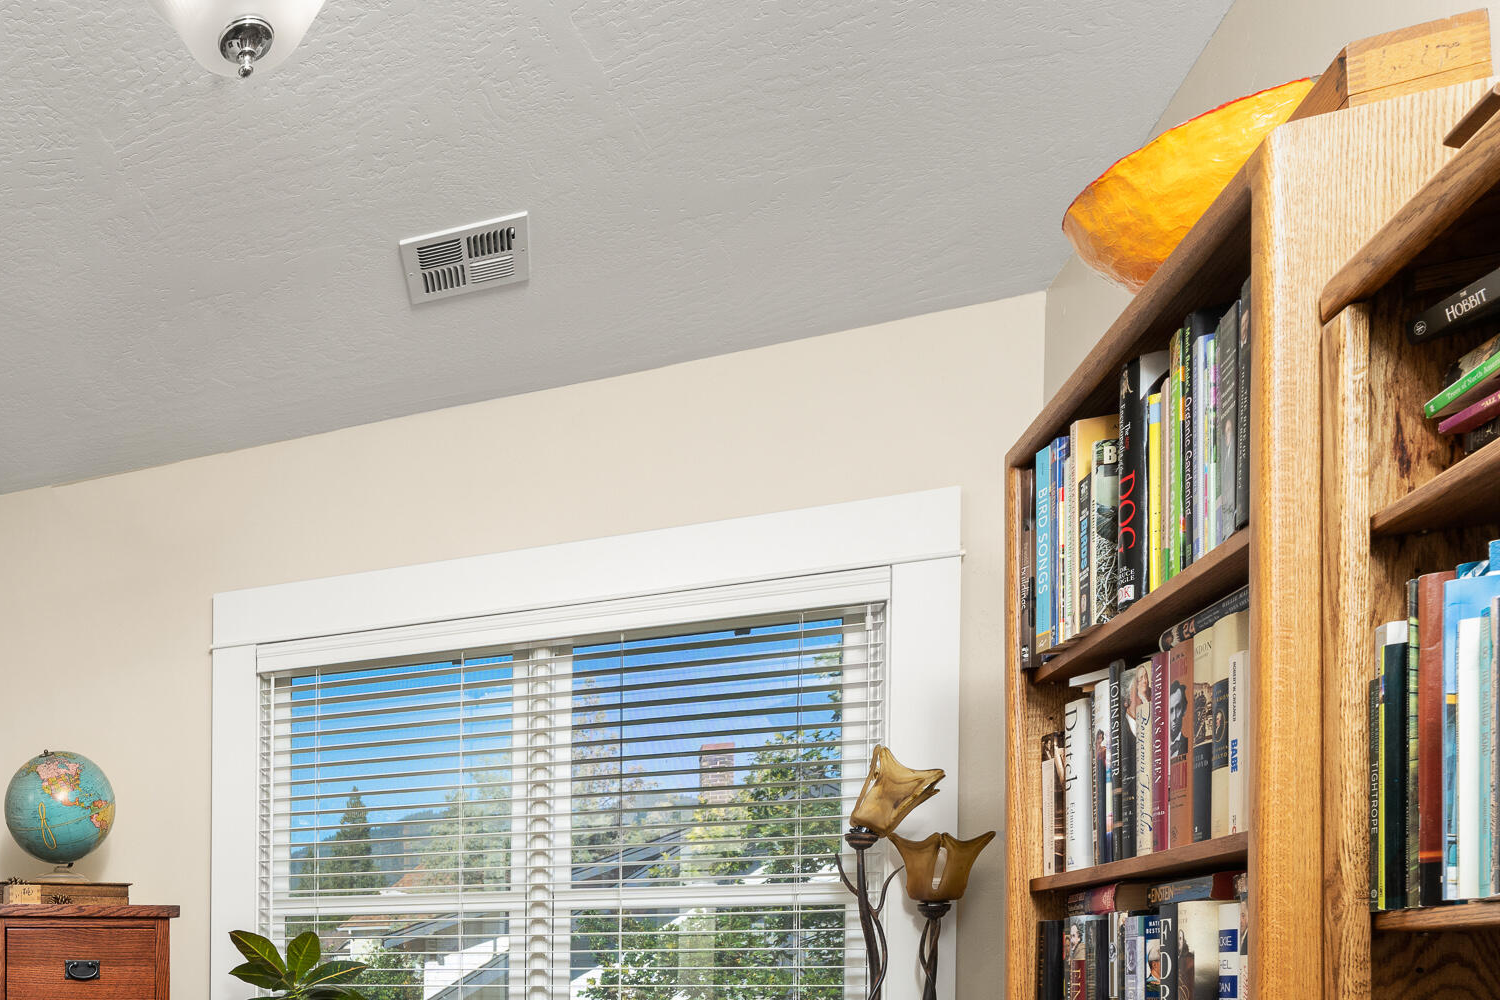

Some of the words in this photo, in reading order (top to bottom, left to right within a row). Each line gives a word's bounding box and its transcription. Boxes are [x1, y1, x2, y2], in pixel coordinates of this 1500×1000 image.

[1445, 288, 1487, 323] HOBBIT
[1446, 386, 1461, 401] Trees
[1467, 370, 1483, 386] North
[1038, 487, 1048, 528] BIRD
[1119, 469, 1136, 552] DOG
[1038, 533, 1049, 595] SONGS
[1080, 518, 1088, 570] BIRDS
[1118, 574, 1135, 585] OGLE
[1119, 569, 1135, 579] RUCE
[1110, 680, 1120, 718] JOHN
[1154, 664, 1164, 735] AMERICA'S
[1065, 709, 1078, 792] Dutch
[1110, 720, 1121, 777] SUTTER
[1138, 704, 1150, 773] Benjamin
[1154, 740, 1162, 784] QUEEN
[1230, 739, 1238, 773] BABE
[1139, 775, 1152, 835] Franklin
[1371, 761, 1379, 835] TIGHTROPE
